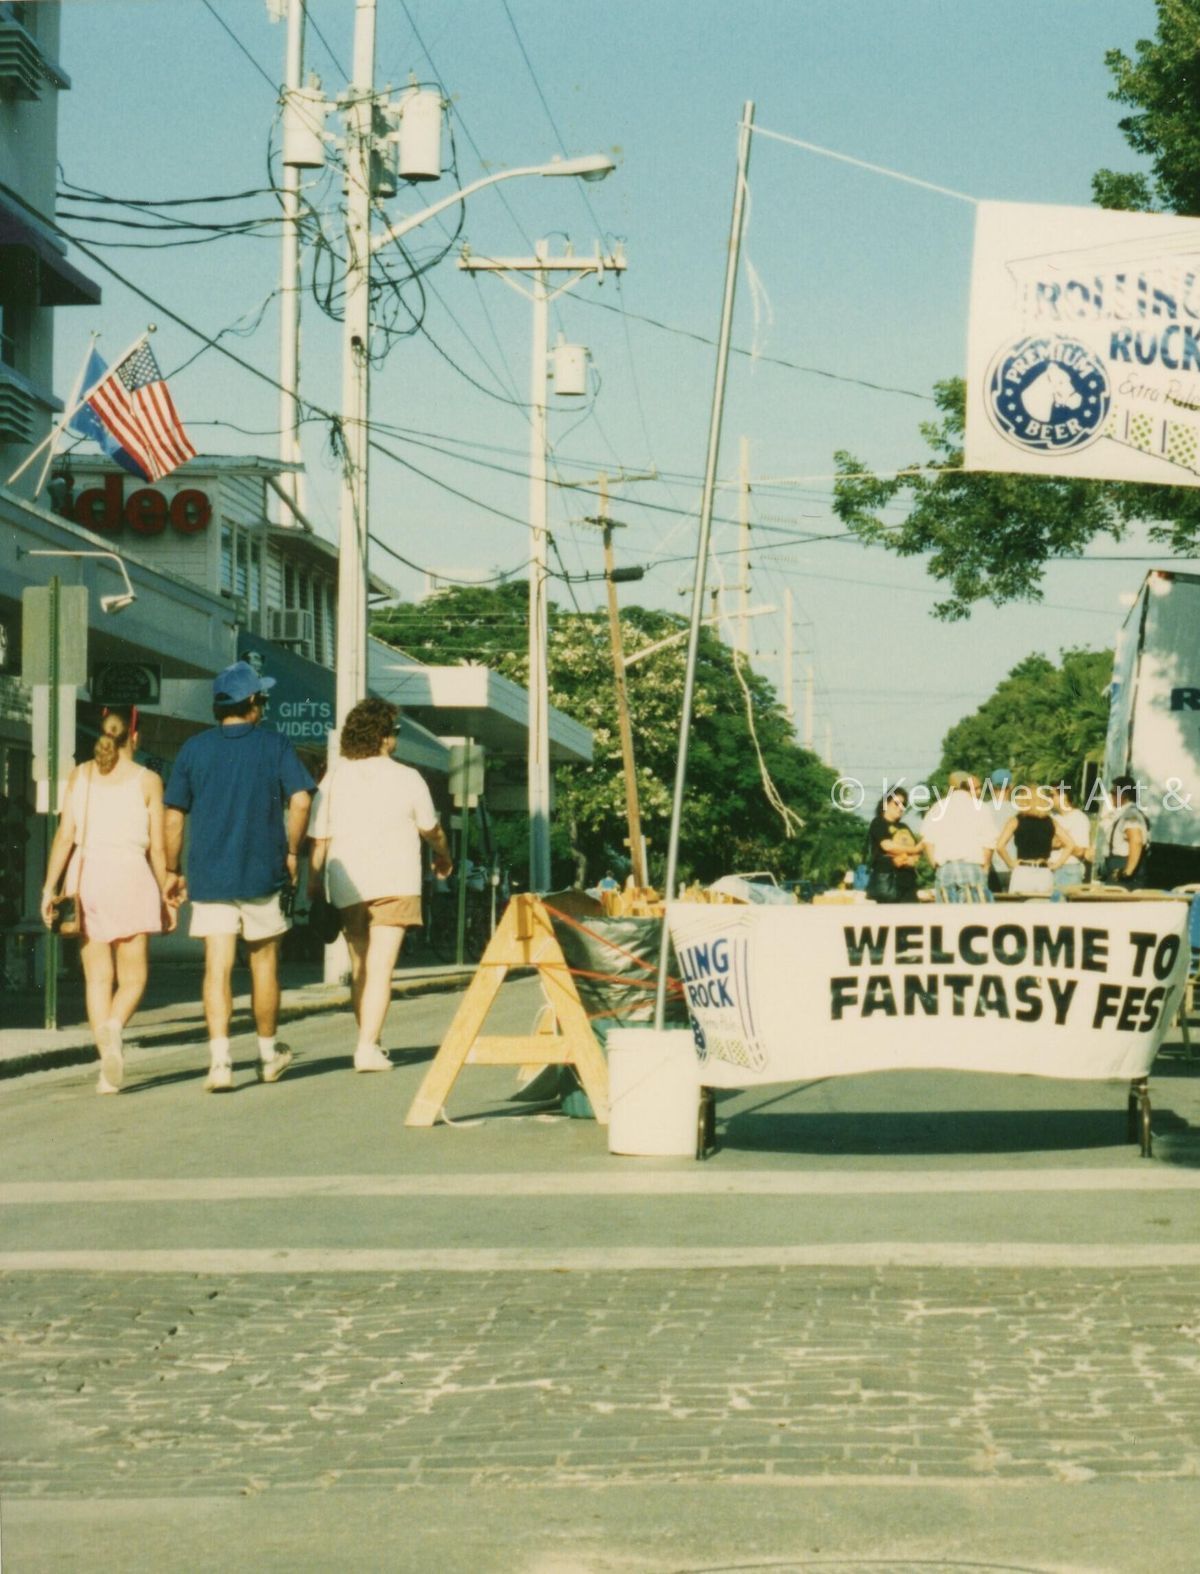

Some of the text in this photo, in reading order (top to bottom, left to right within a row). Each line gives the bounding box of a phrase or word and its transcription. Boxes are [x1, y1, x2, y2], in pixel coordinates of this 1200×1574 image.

[1024, 418, 1083, 440] BEER
[280, 702, 331, 718] GIFTS
[276, 721, 333, 737] VIDEOS
[679, 938, 730, 983] LING
[843, 924, 1181, 981] WELCOME TO
[687, 976, 735, 1008] ROCK
[830, 974, 1078, 1025] FANTASY
